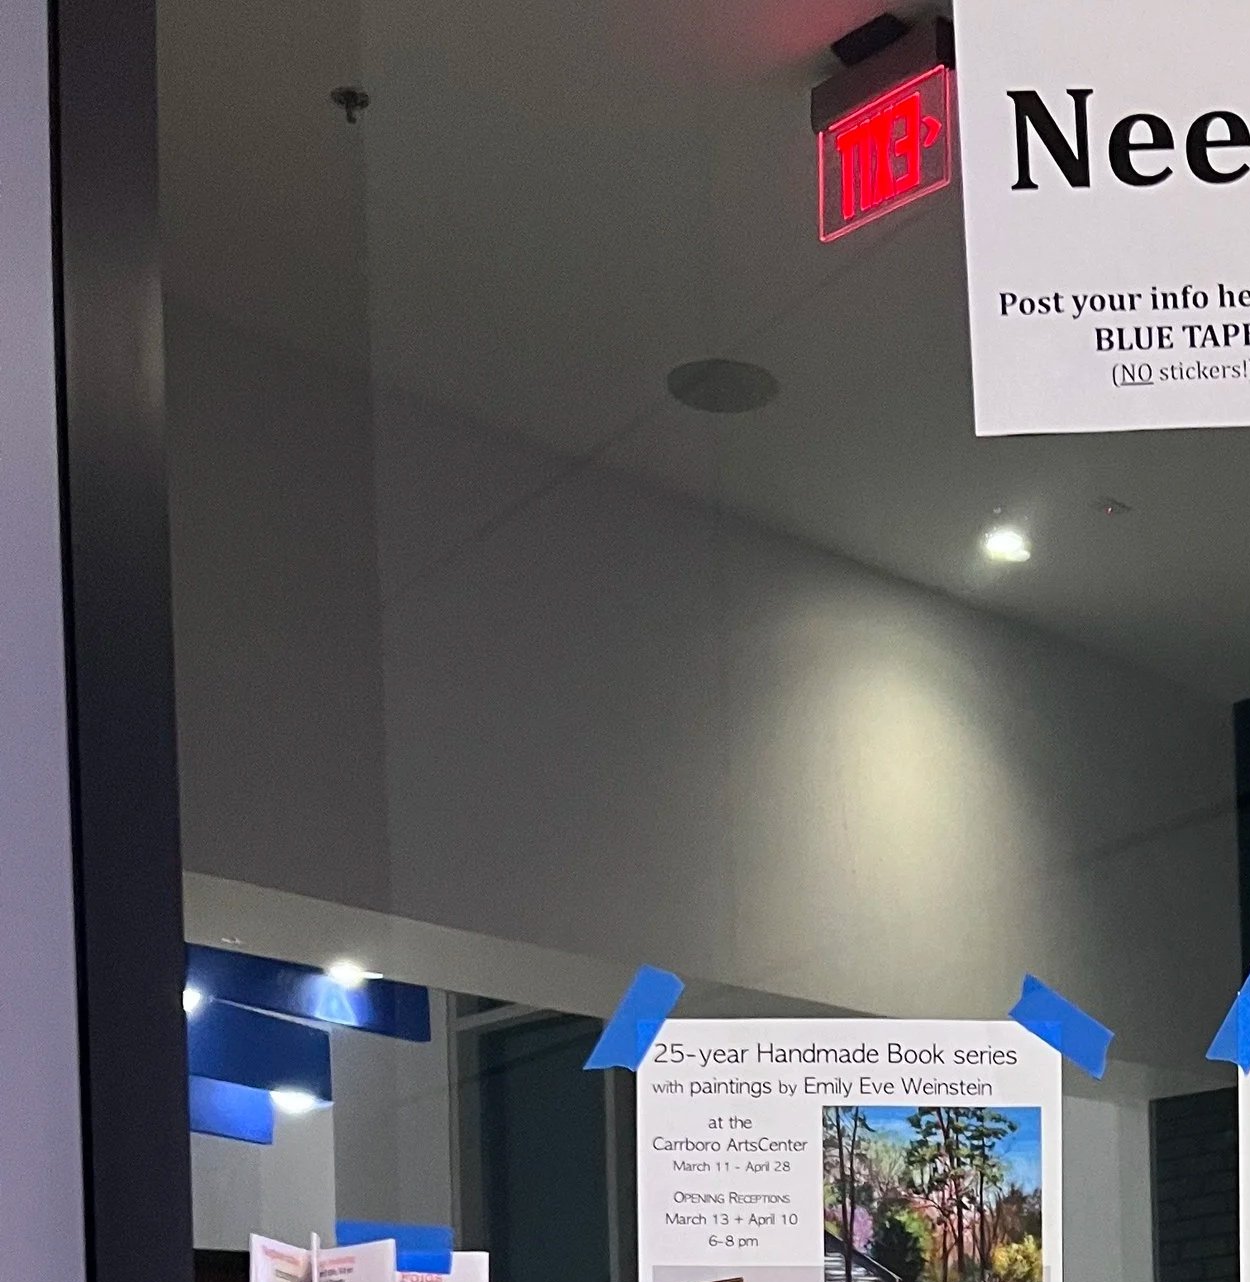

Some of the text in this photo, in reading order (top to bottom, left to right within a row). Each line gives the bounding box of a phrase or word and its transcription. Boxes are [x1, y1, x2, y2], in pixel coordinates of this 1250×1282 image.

[1000, 293, 1063, 315] Post
[1072, 294, 1141, 319] your
[1151, 285, 1208, 309] info
[1095, 326, 1173, 351] BLUE
[1113, 364, 1153, 386] (NO
[655, 1043, 1017, 1067] 25-year Handmade Book series
[653, 1137, 808, 1151] Carrboro ArtsCenter
[674, 1191, 790, 1204] OPENING RECEPTIONS
